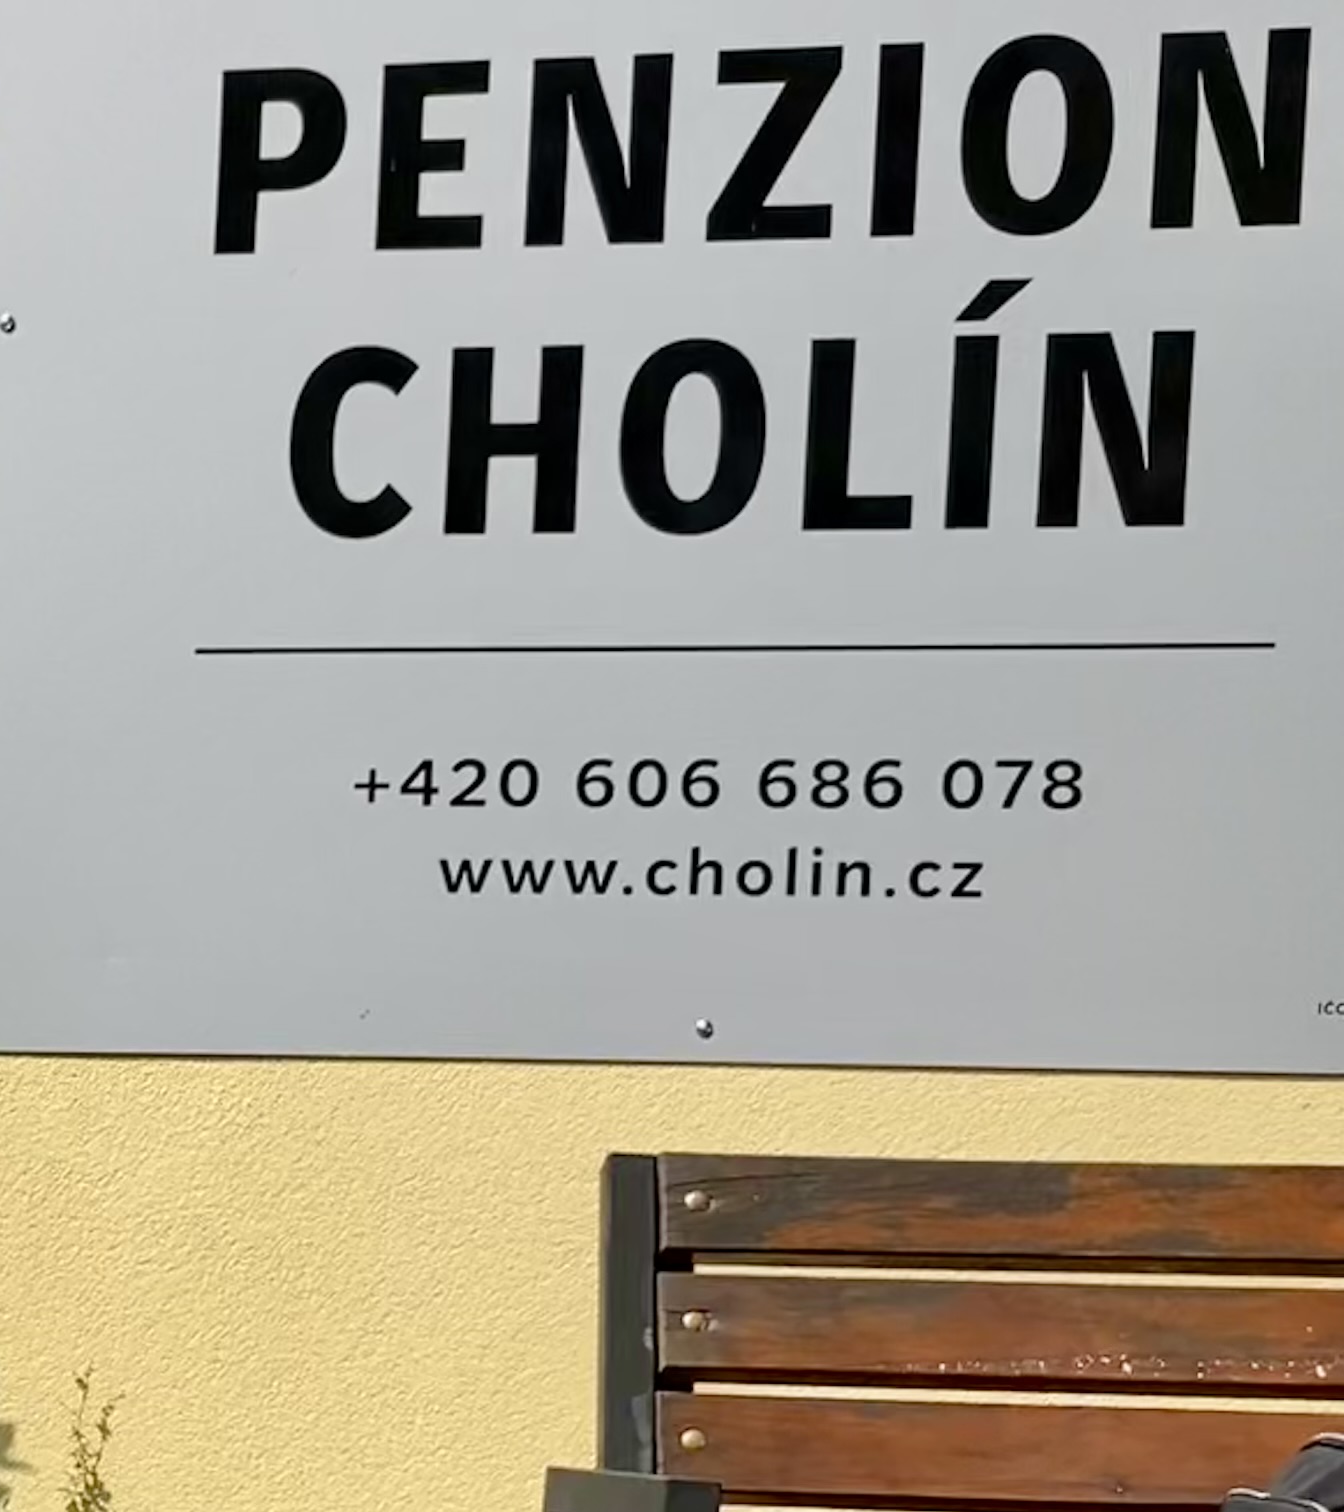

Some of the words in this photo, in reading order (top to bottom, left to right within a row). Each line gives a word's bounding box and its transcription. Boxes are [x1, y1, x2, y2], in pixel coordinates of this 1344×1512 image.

[214, 27, 1312, 255] PENZION
[289, 278, 1196, 539] CHOLÍN
[354, 758, 539, 807] +420
[576, 758, 720, 808] 606
[759, 759, 903, 809] 686
[942, 759, 1083, 810] 078
[439, 846, 984, 898] www.cholin.cz
